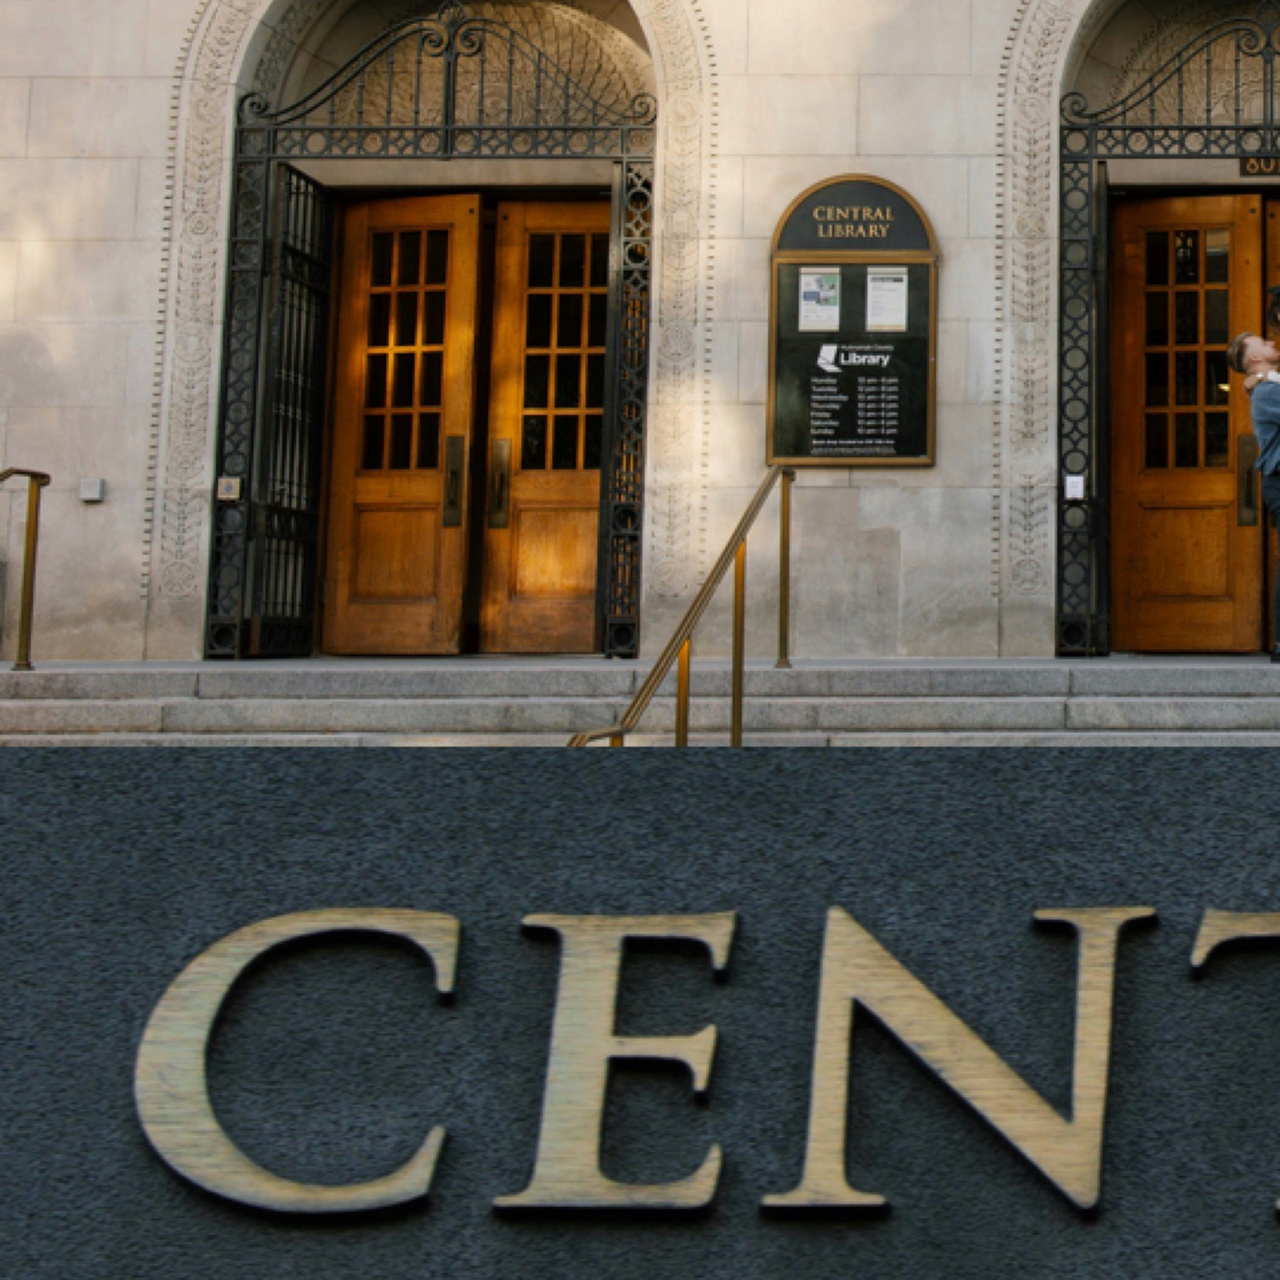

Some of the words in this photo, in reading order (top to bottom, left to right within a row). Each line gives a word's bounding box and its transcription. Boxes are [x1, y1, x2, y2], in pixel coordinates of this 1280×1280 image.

[812, 206, 895, 221] CENTRAL
[817, 224, 891, 238] LIBRARY
[839, 352, 891, 368] Library
